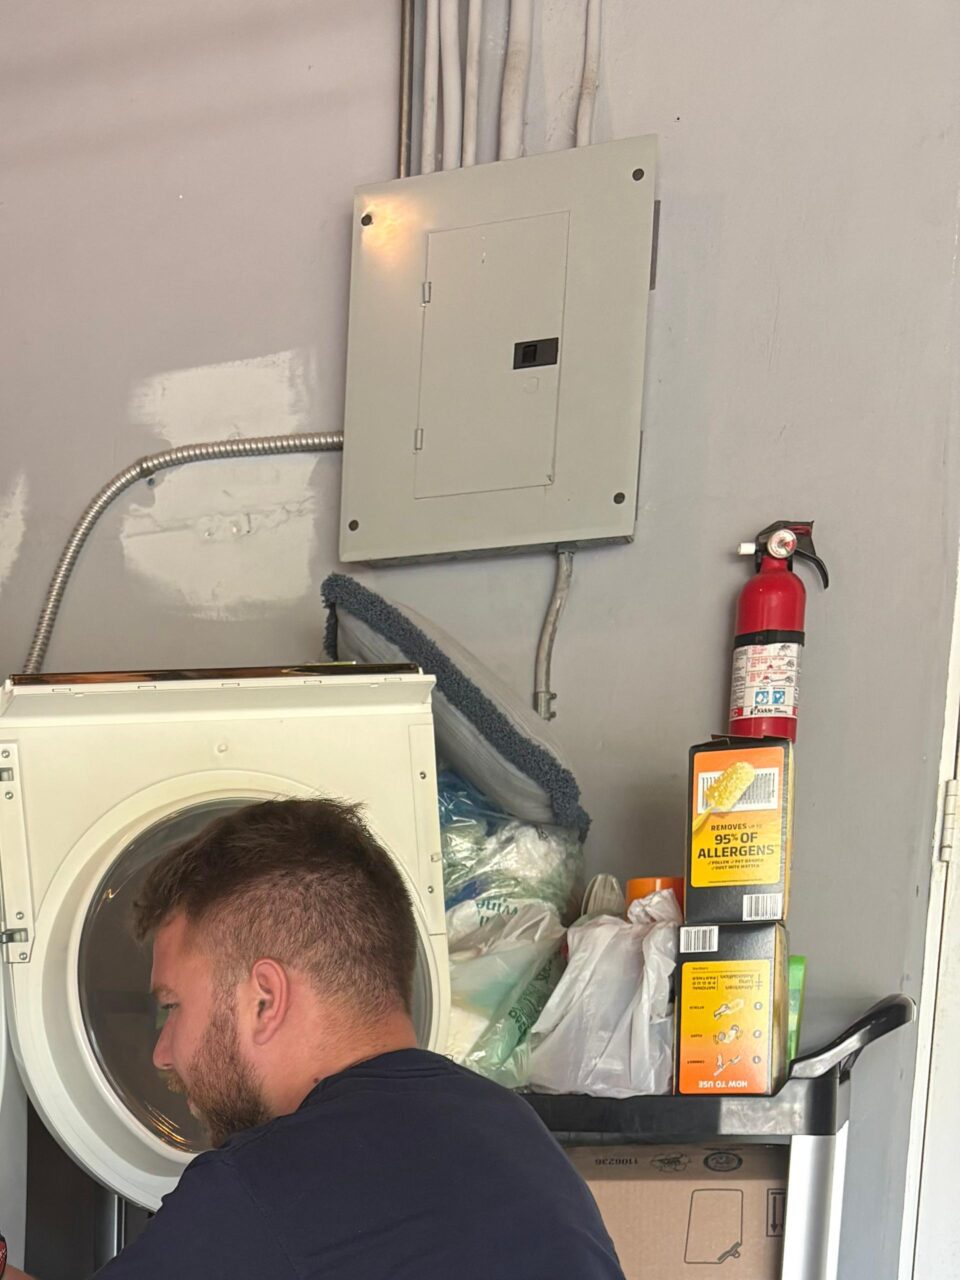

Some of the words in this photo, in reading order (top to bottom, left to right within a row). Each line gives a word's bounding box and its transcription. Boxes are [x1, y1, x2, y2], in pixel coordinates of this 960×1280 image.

[711, 823, 747, 831] REMOVES
[714, 833, 738, 845] 95%
[740, 832, 758, 843] OF
[697, 845, 774, 859] ALLERGENS
[698, 1080, 714, 1088] USE
[716, 1080, 727, 1088] TO
[728, 1080, 748, 1088] HOW
